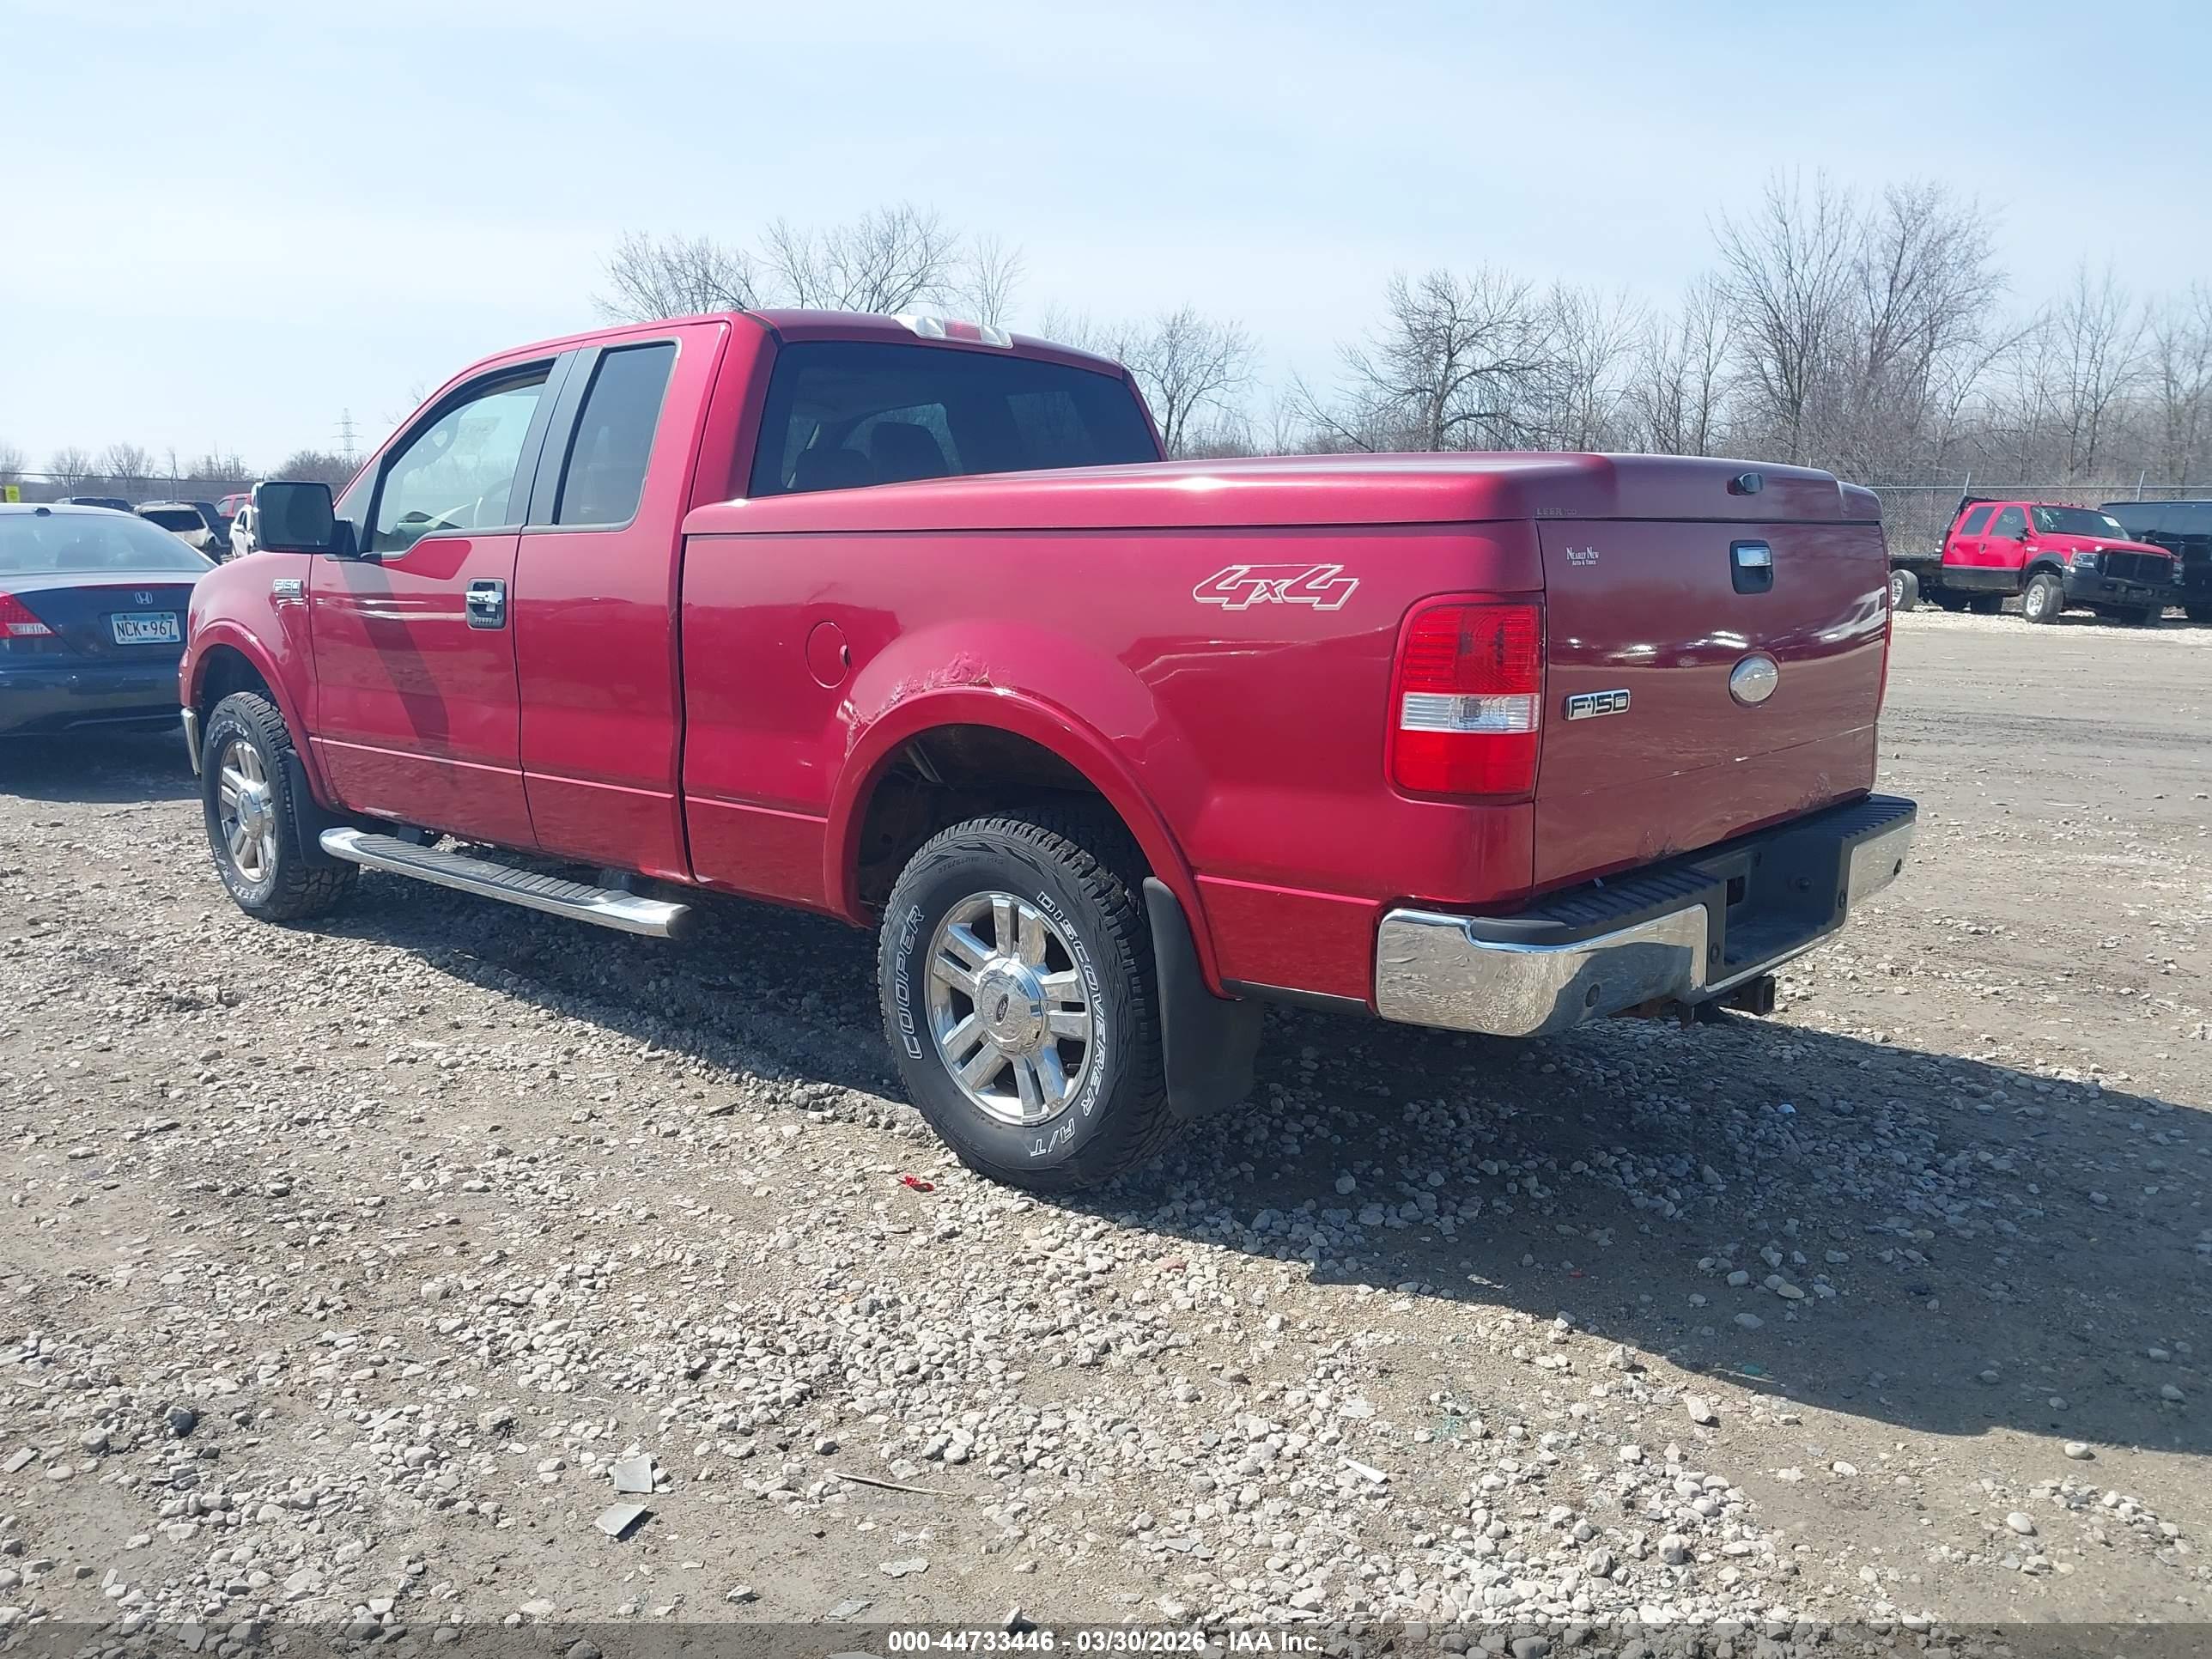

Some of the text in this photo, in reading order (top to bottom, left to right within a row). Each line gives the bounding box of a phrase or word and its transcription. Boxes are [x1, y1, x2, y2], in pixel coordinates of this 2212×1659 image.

[116, 620, 173, 637] NCK 967
[1193, 563, 1360, 611] 4x4
[896, 904, 925, 1060] COOPER
[1030, 891, 1107, 1157] DISCOVERER A/T
